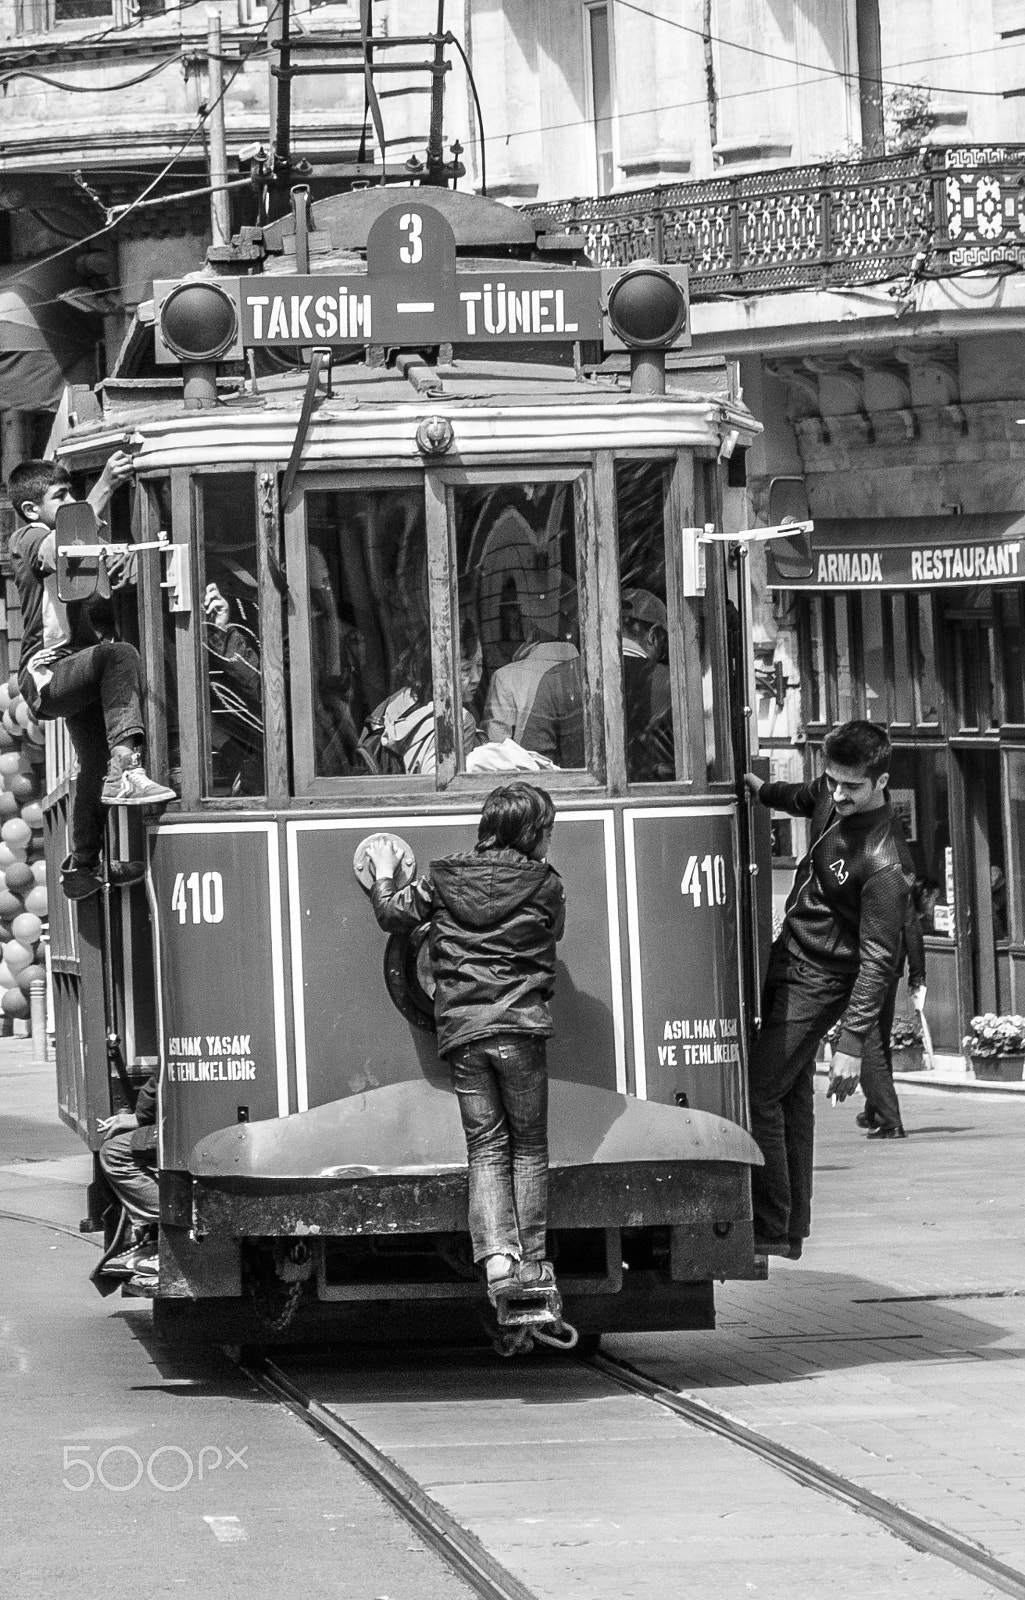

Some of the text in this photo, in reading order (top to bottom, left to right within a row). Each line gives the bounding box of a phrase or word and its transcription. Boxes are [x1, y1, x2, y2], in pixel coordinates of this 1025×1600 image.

[400, 213, 424, 264] 3
[247, 286, 372, 339] TAKSİM
[459, 283, 579, 335] TÜNEL
[817, 543, 1021, 583] ARMADA RESTAURANT
[171, 871, 225, 925] 410
[680, 854, 727, 908] 410
[205, 1034, 252, 1056] YASAK
[657, 1045, 678, 1067] VE
